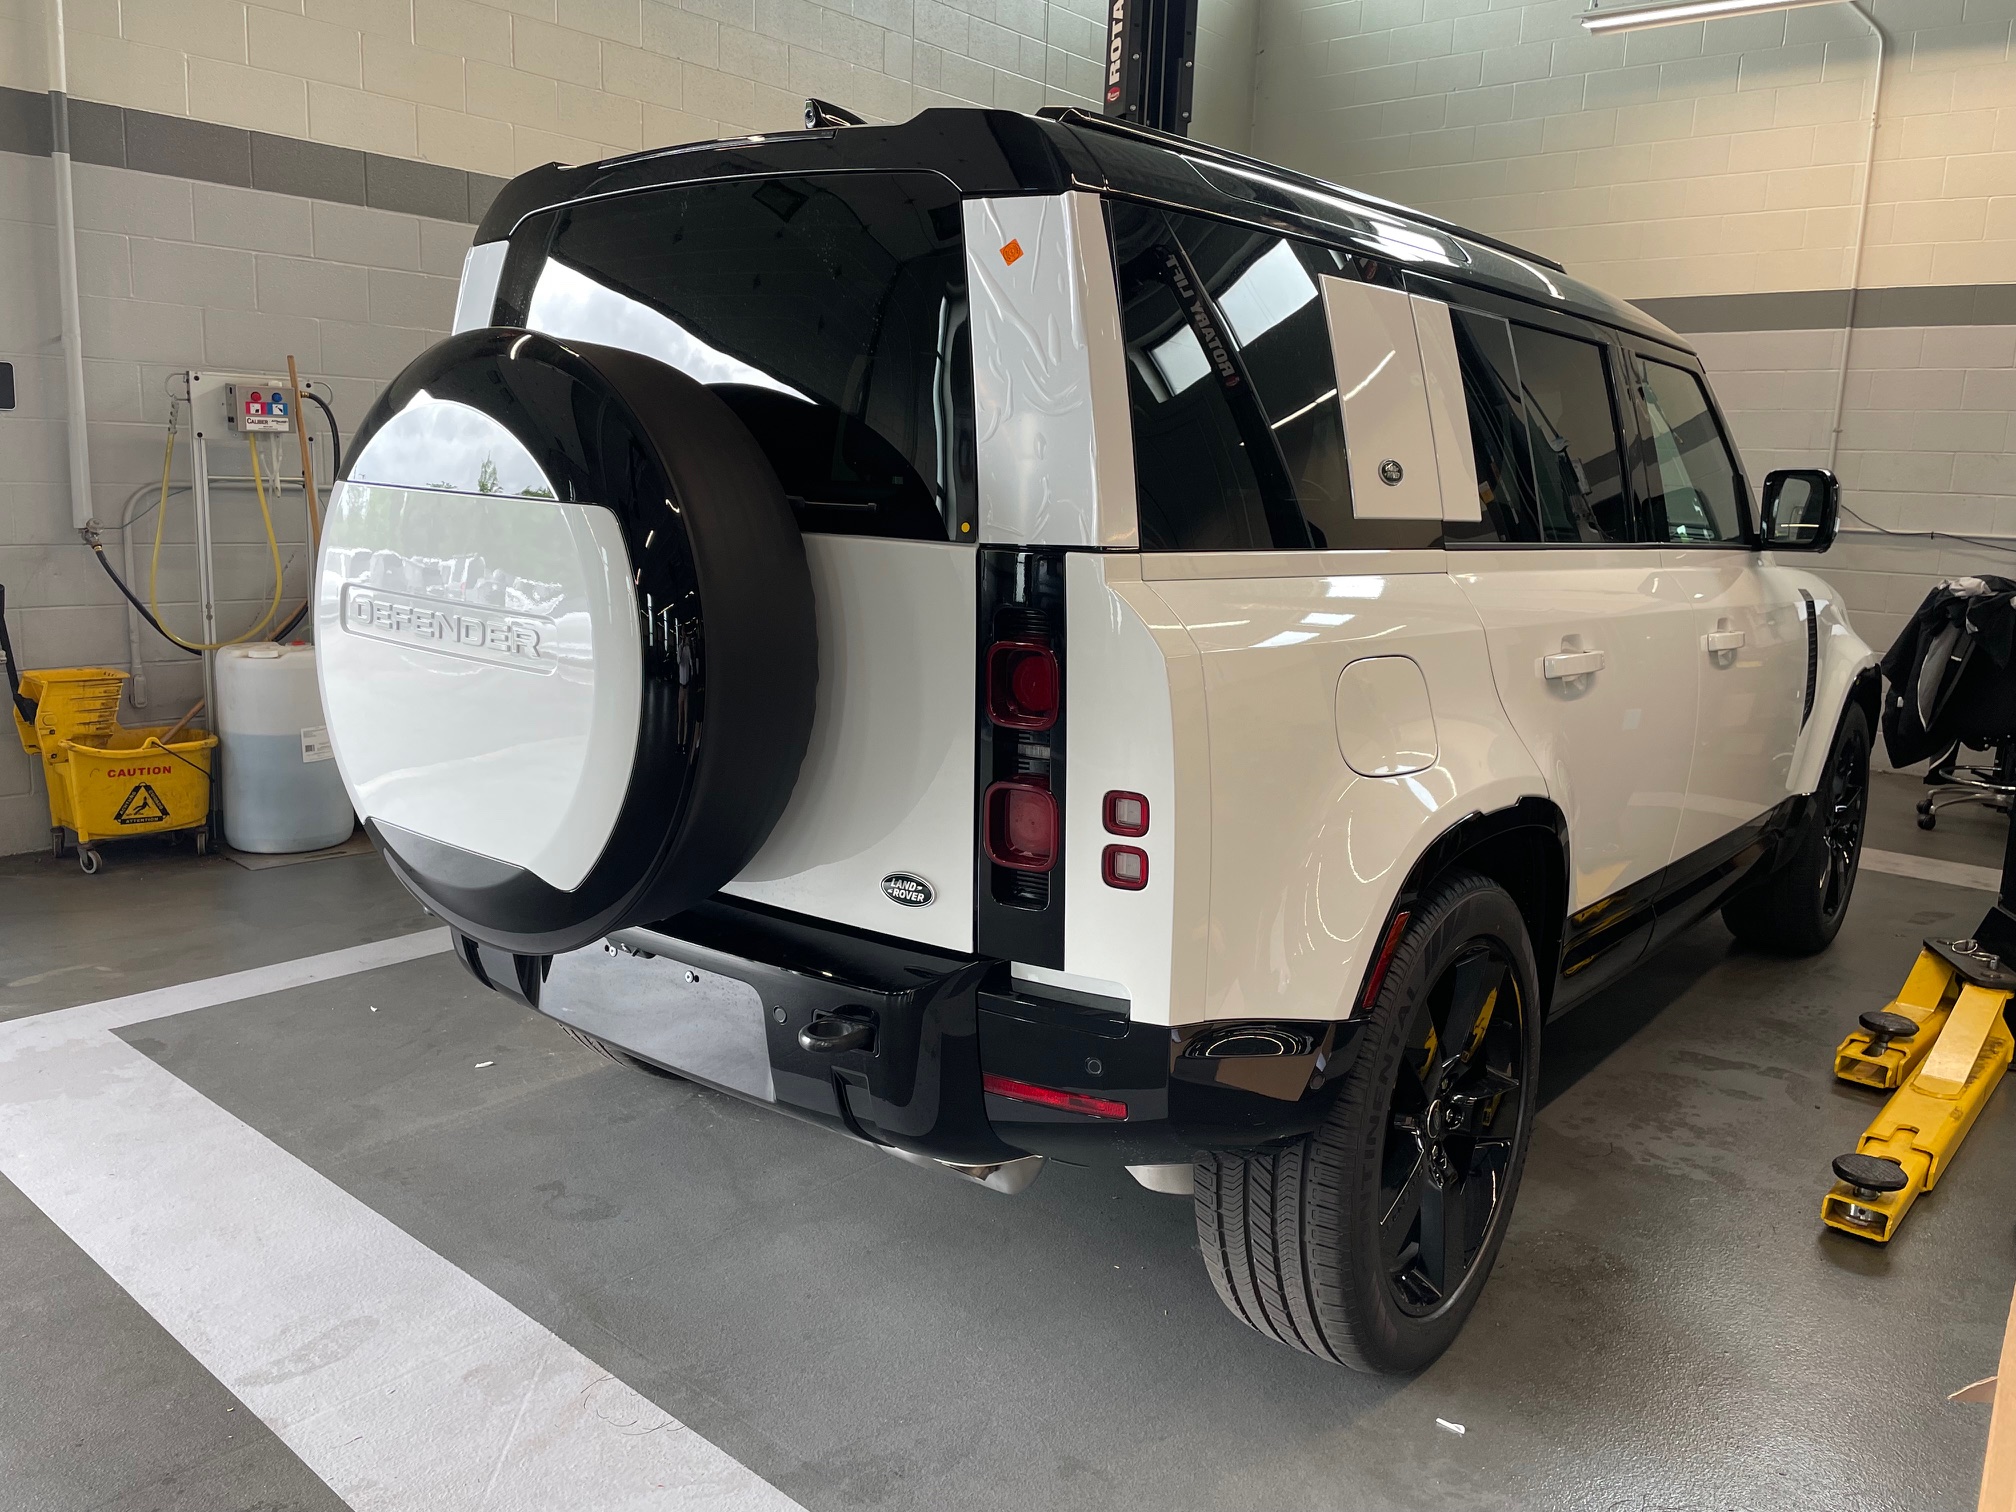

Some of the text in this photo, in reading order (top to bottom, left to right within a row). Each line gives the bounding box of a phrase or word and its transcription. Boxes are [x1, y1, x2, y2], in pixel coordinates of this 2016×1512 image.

[351, 596, 541, 658] DEFENDER
[107, 766, 172, 778] CAUTION
[891, 878, 916, 891] LAND
[893, 889, 924, 902] ROVER
